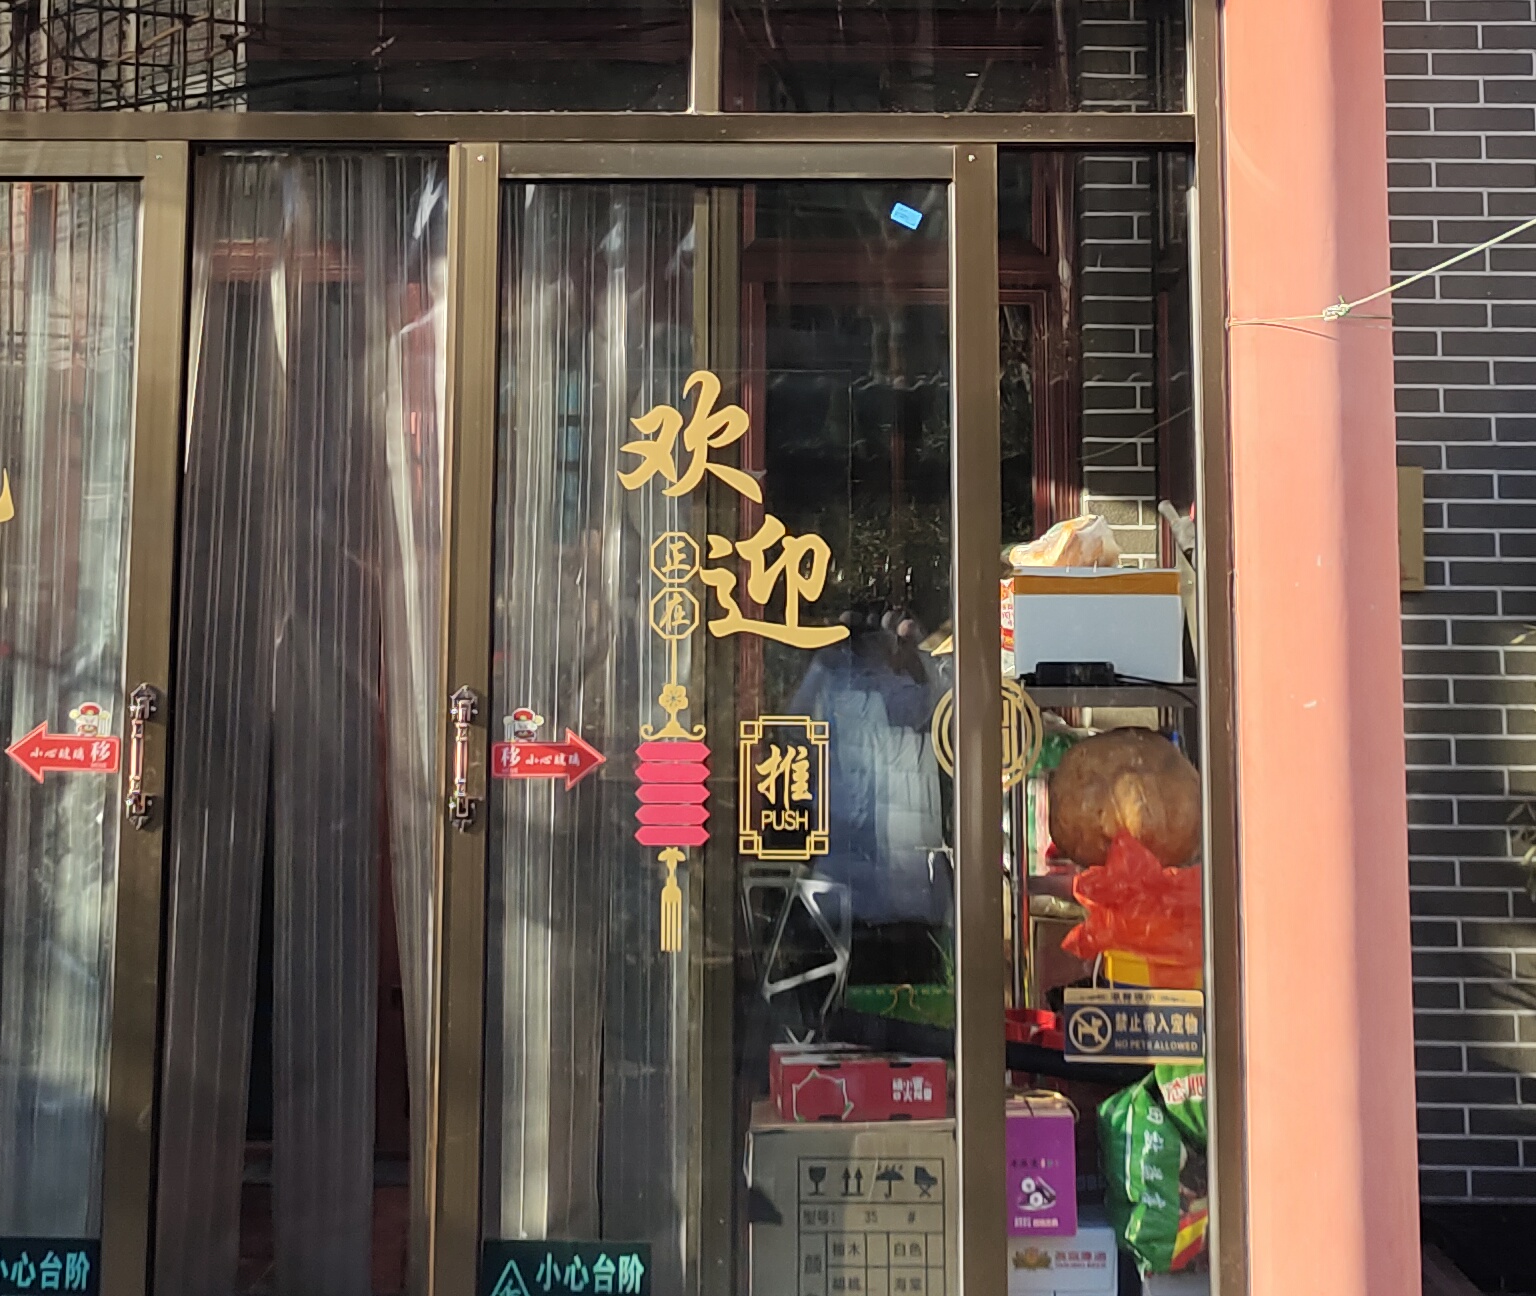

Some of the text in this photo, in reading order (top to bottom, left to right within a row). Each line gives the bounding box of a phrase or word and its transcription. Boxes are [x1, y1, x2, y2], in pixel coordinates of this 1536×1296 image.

[617, 371, 850, 647] 欢迎
[658, 543, 692, 631] 正在
[756, 744, 812, 809] 推
[762, 810, 808, 832] PUSH
[1115, 1039, 1129, 1050] NO
[1154, 1040, 1198, 1053] ALLOWED
[535, 1251, 644, 1294] 小心台阶
